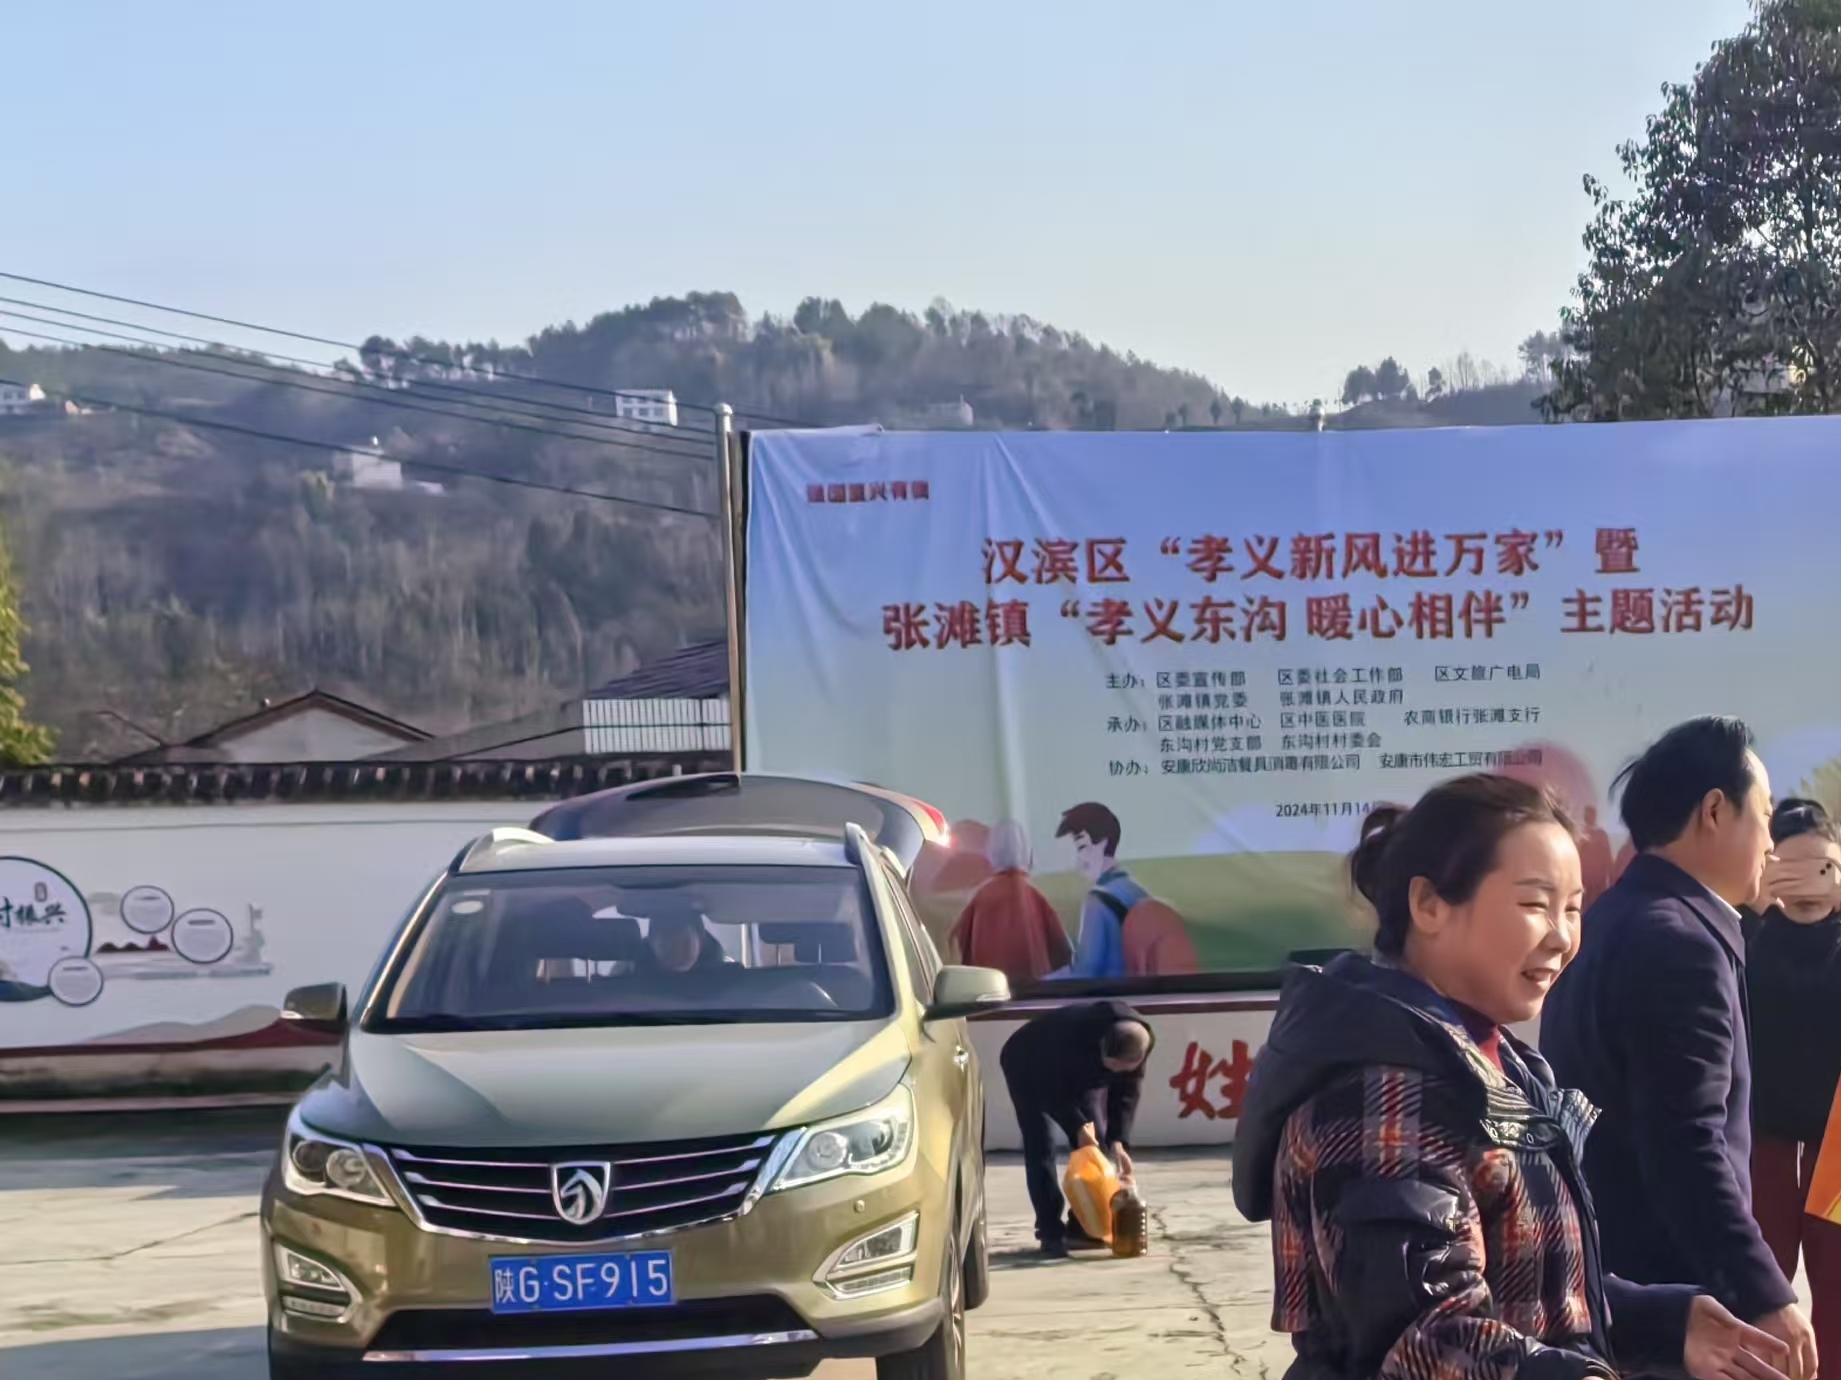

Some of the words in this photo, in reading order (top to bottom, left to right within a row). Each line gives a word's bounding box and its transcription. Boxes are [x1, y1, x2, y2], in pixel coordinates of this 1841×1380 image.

[1279, 688, 1404, 707] 张滩镇人民政府
[1160, 735, 1263, 753] 东沟村党支部
[1281, 732, 1383, 750] 东沟村村委会
[1275, 801, 1376, 818] 2024年11月14
